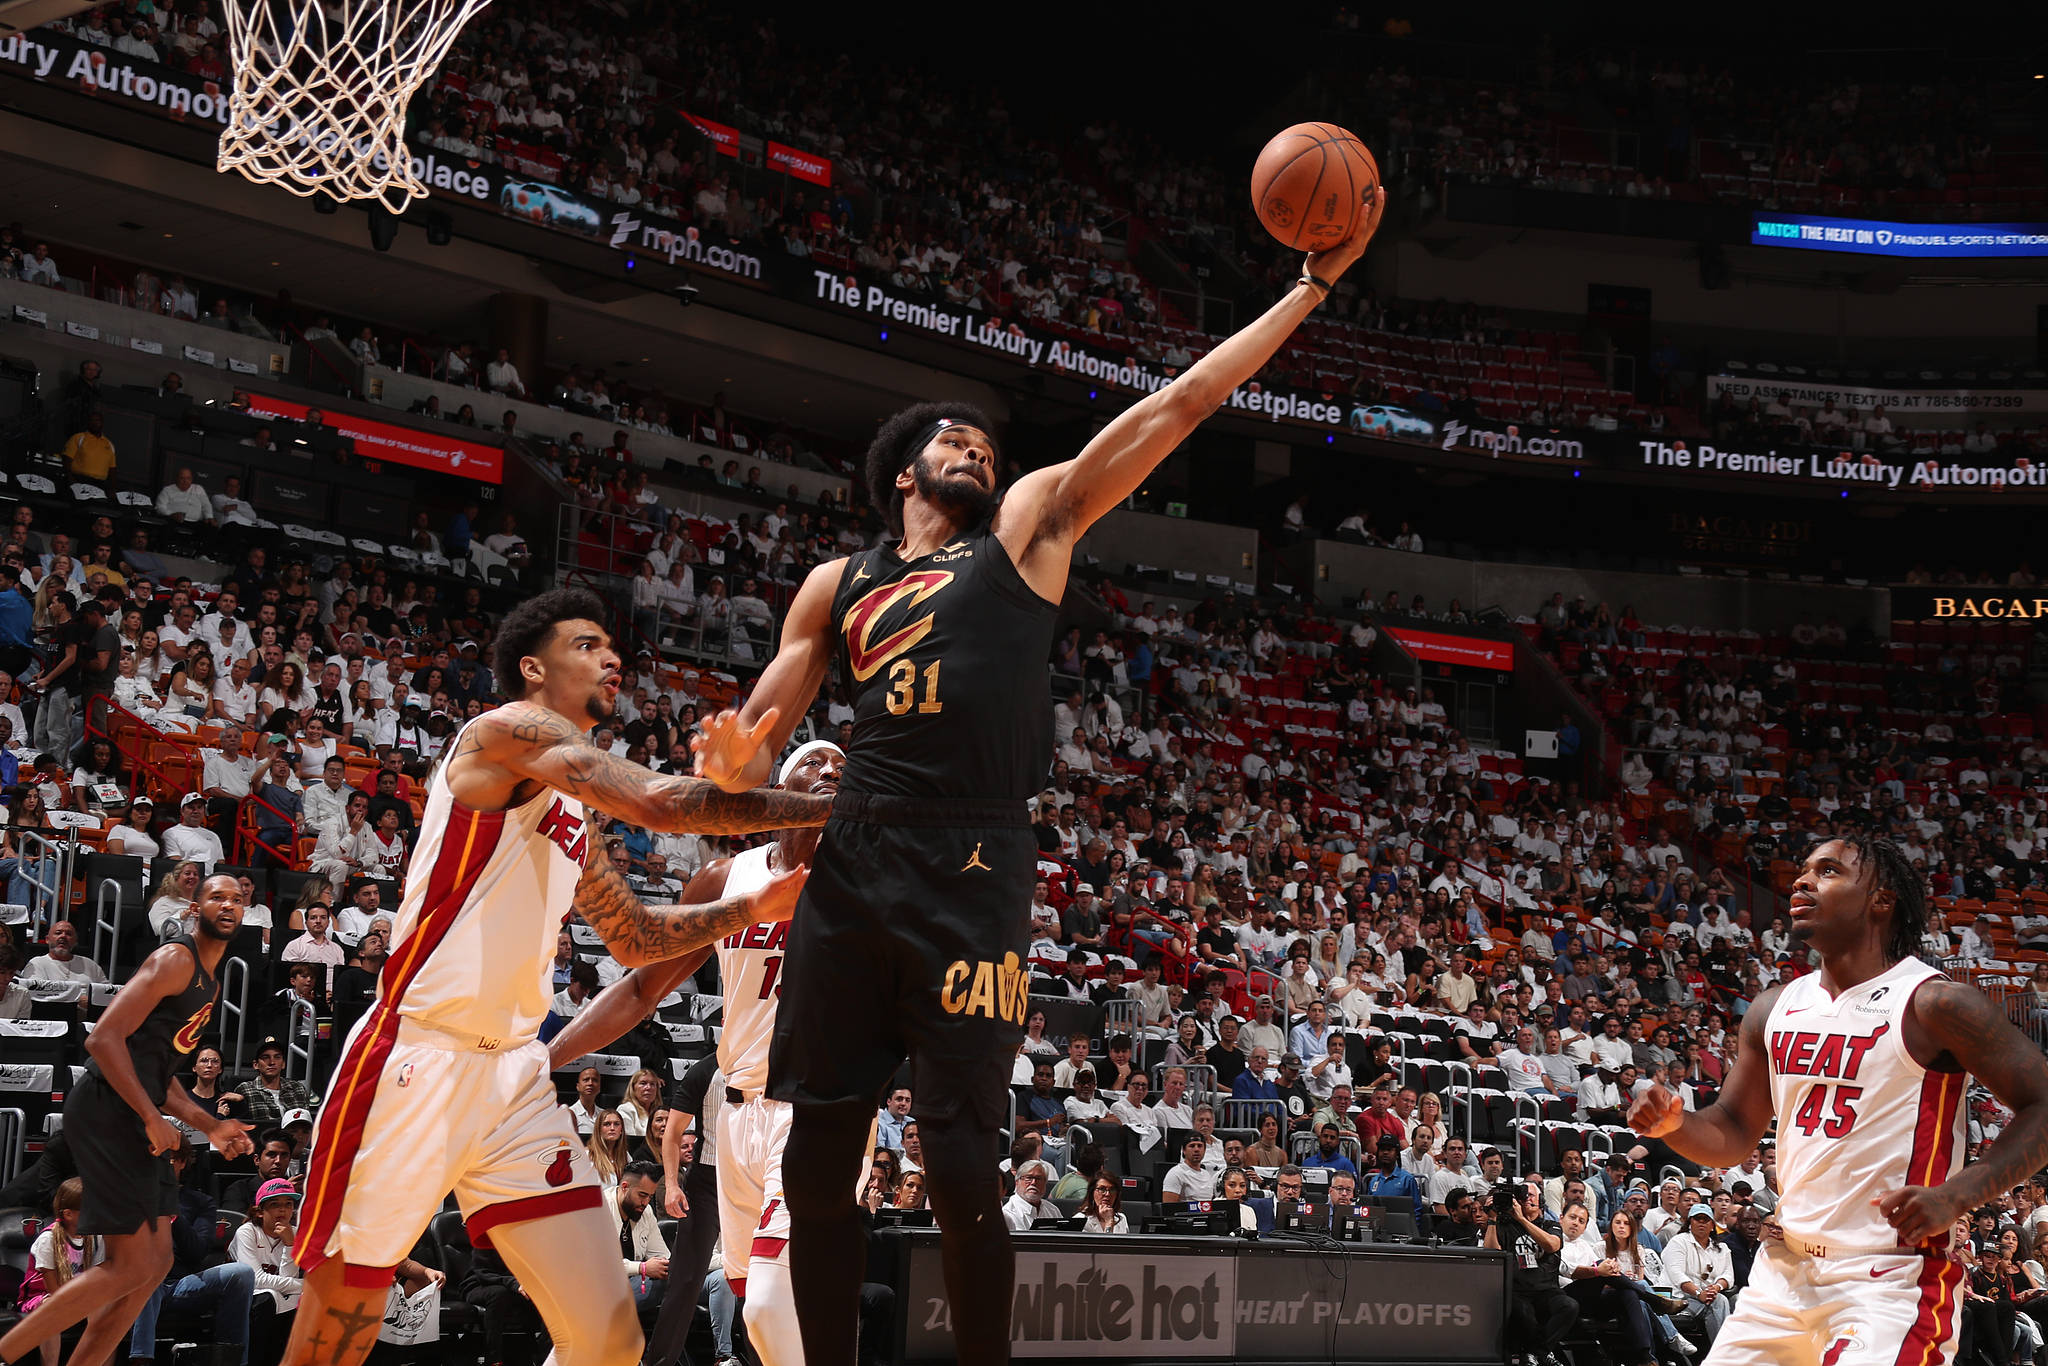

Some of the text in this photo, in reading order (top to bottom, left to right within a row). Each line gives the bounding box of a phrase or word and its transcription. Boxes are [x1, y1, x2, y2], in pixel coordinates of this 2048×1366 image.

[643, 226, 760, 279] mph.com
[1758, 222, 1799, 239] WATCH
[1800, 225, 1824, 241] THE
[1825, 227, 1854, 243] HEAT
[1856, 229, 1873, 244] ON
[1894, 234, 1948, 246] FANDUEL
[1949, 235, 1995, 246] SPORTS
[814, 270, 860, 307] The
[866, 287, 960, 335] Premier
[965, 315, 1043, 364] Luxury
[1221, 386, 1342, 424] ketplace
[1715, 382, 1749, 396] NEED
[1753, 386, 1840, 403] ASSISTANCE?
[1844, 393, 1877, 407] TEXT
[1881, 395, 1899, 407] US
[1904, 395, 1920, 407] AT
[1470, 429, 1583, 458] mph.com
[1640, 441, 1691, 467] The
[1698, 446, 1804, 475] Premier
[1811, 454, 1903, 488] Luxury
[932, 550, 973, 563] CLIFFS
[886, 658, 943, 716] 31
[941, 953, 1029, 1026] CAVS
[1855, 1004, 1890, 1015] Robinhood
[1771, 1020, 1890, 1081] HEAT
[1796, 1084, 1864, 1139] 45
[1011, 1256, 1220, 1342] white hot
[1236, 1291, 1472, 1327] HEAT PLAYOFFS
